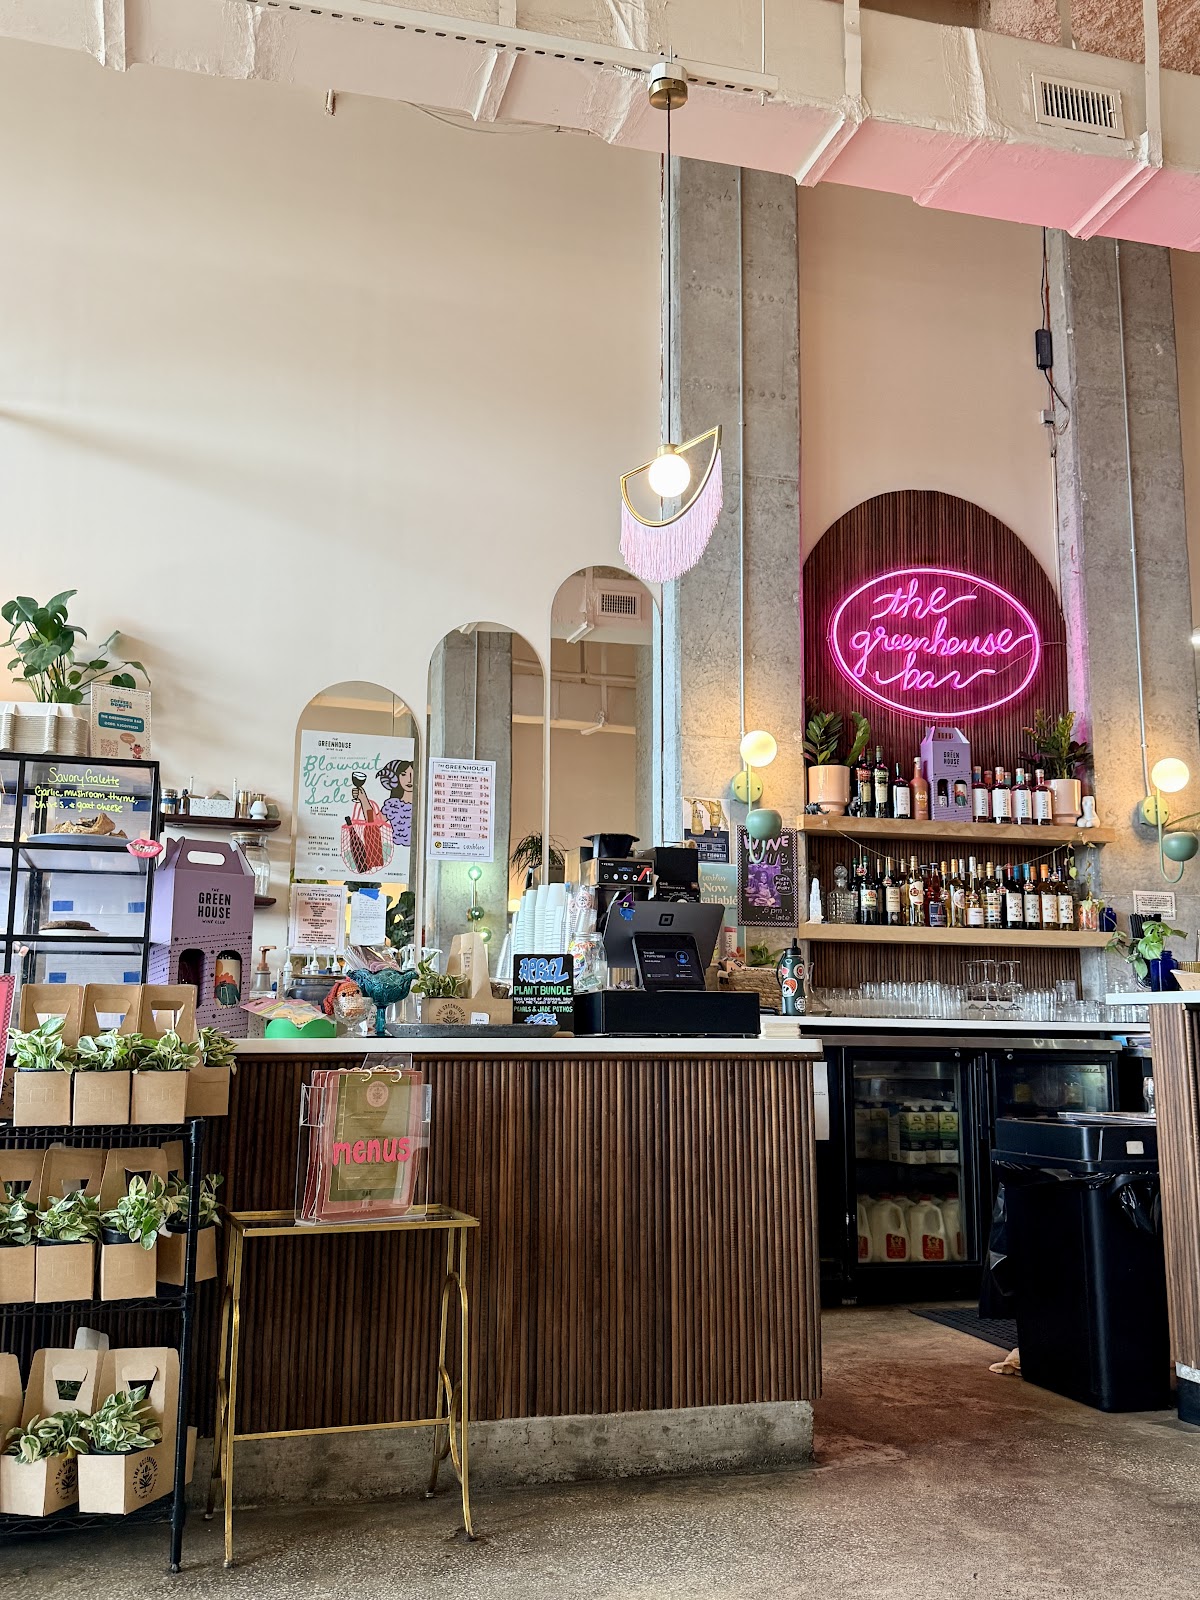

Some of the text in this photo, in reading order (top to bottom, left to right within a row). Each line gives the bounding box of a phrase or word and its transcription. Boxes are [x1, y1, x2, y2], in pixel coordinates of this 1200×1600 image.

[873, 577, 977, 619] the
[850, 616, 1034, 678] greenhouse
[874, 651, 996, 692] bar
[318, 740, 352, 749] GREENHOUSE
[944, 751, 960, 759] GREEN
[944, 758, 960, 766] HOUSE
[304, 753, 383, 772] Blowout
[445, 764, 490, 772] GREENHOUSE
[48, 767, 120, 787] Savory Galette
[304, 771, 353, 788] Wine
[63, 788, 107, 801] mushroom,
[304, 787, 351, 805] Sale
[96, 802, 124, 813] cheese
[743, 834, 790, 851] WNE
[702, 882, 728, 893] Now
[198, 892, 231, 906] GREEN
[197, 905, 231, 919] HOUSE
[513, 985, 572, 996] PLANT BUNDLE
[537, 1005, 551, 1013] JADE
[552, 1005, 574, 1013] POTHOS
[333, 1137, 411, 1167] menus
